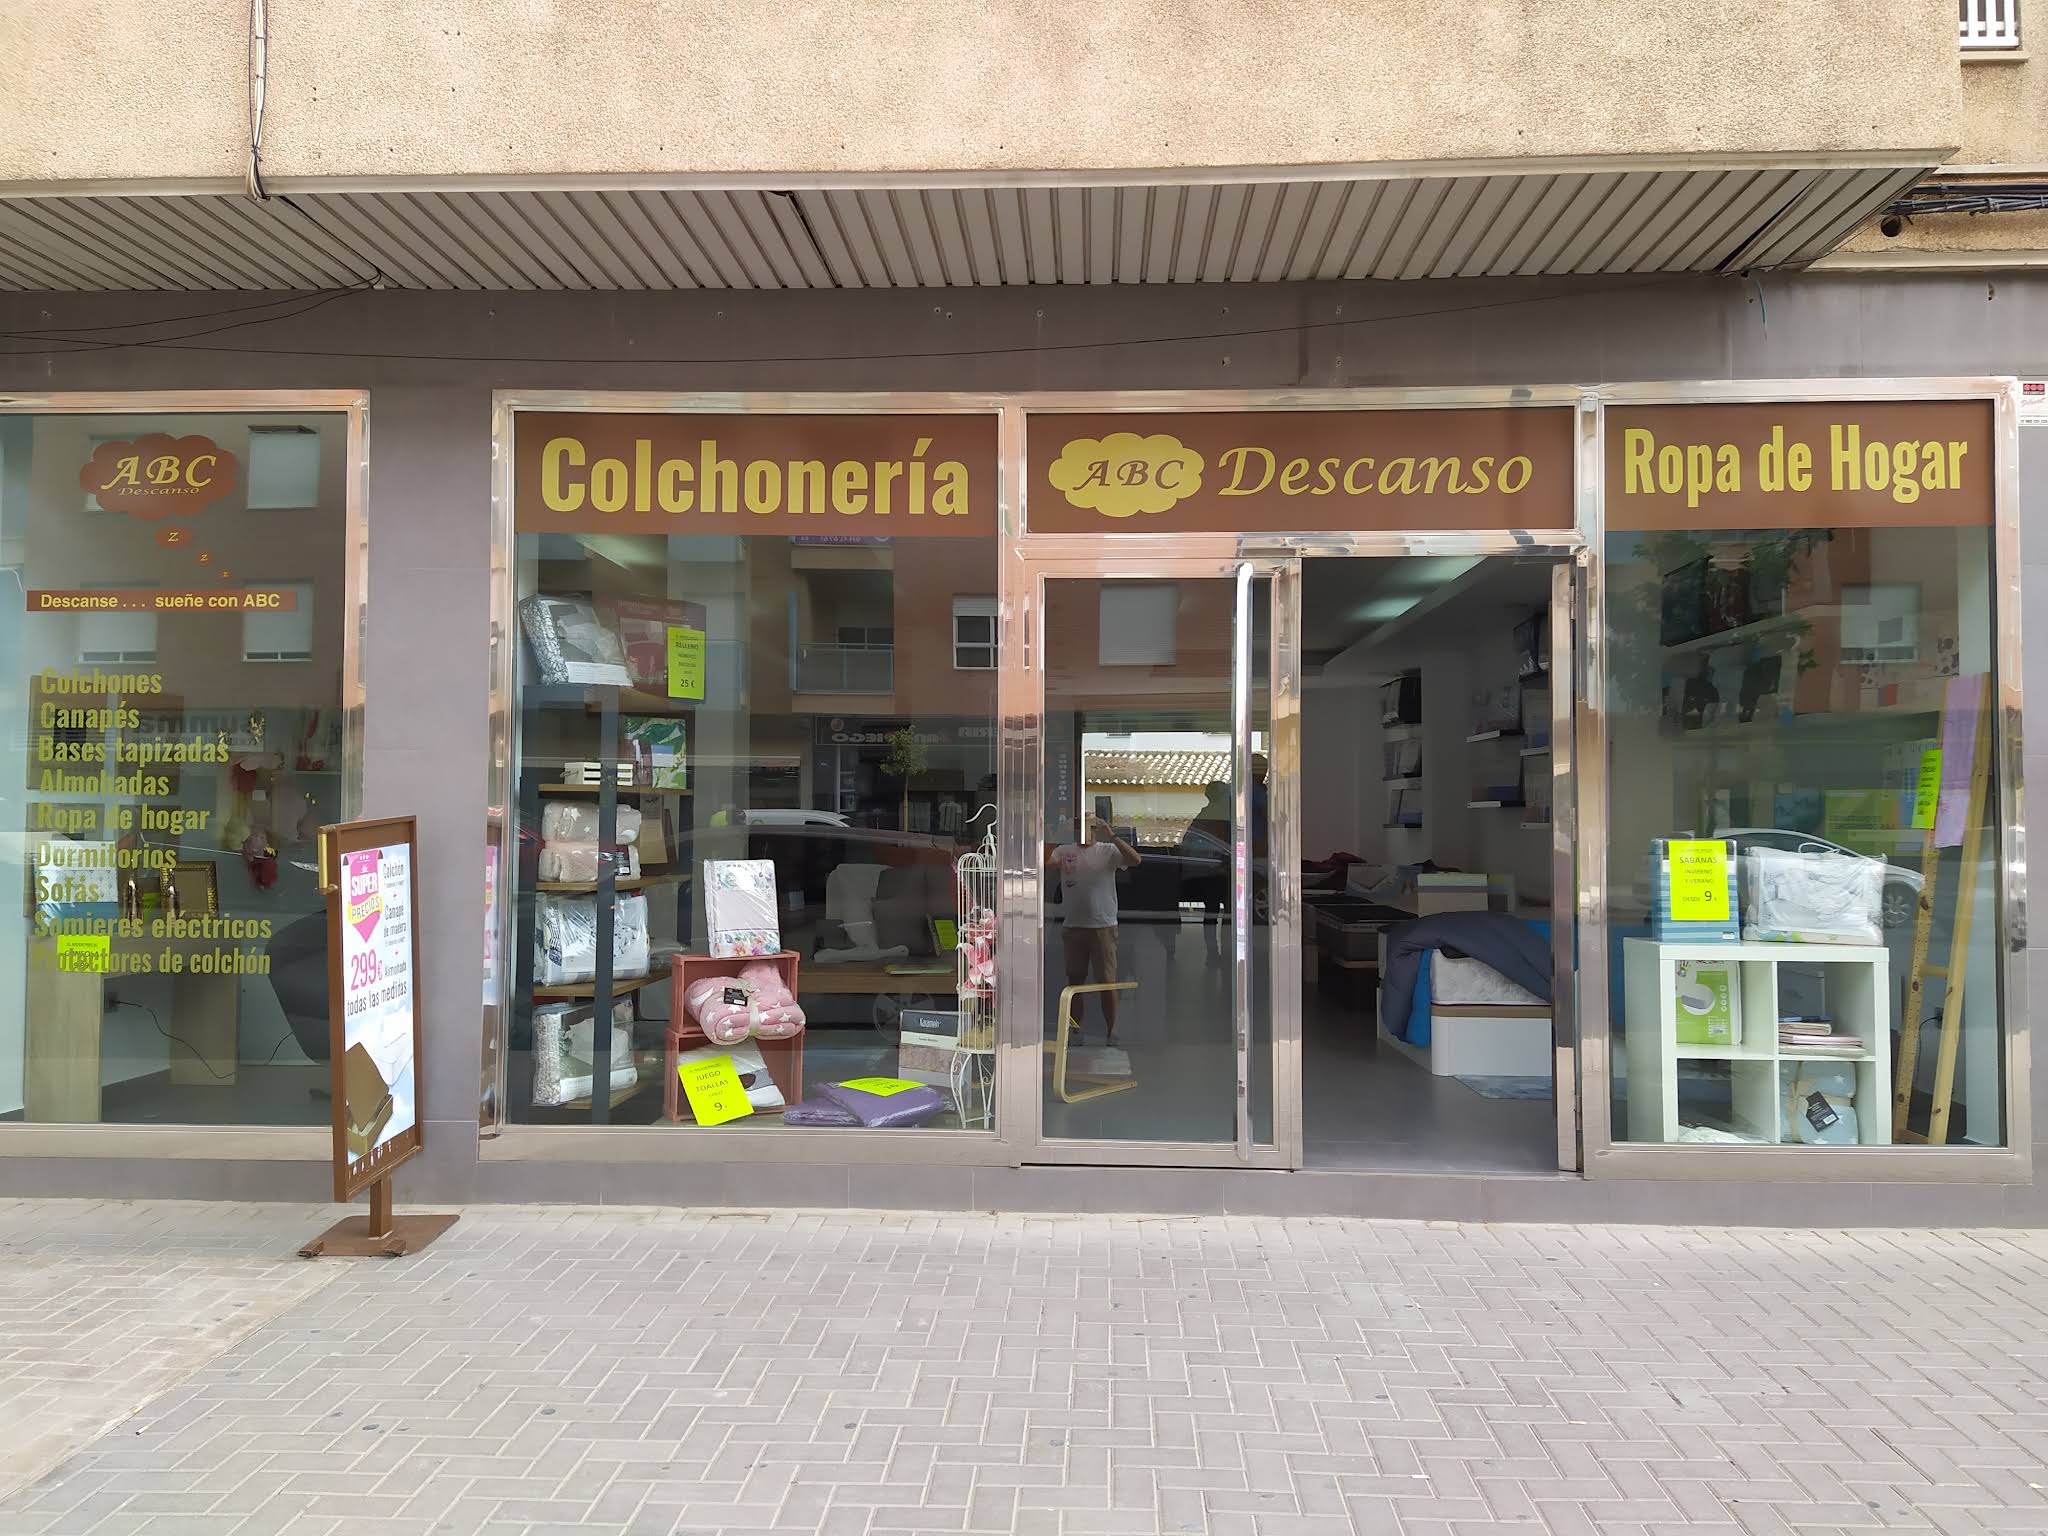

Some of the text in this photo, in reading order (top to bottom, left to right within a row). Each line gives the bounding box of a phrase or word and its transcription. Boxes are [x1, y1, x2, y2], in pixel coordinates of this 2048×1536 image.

[101, 455, 217, 490] ABC
[541, 437, 970, 516] Colchonería
[1072, 446, 1533, 497] ABC Descanso
[1624, 424, 1968, 508] Ropa de Hogar
[118, 486, 200, 496] Descanso
[40, 594, 118, 608] Descanse
[155, 594, 203, 608] sueñe
[208, 597, 238, 608] con
[243, 593, 280, 608] ABC
[40, 668, 162, 694] Colchones
[680, 679, 689, 688] 25
[40, 701, 140, 729] Canapés
[38, 735, 229, 770] Bases tapizadas
[40, 769, 169, 795] Almohadas
[38, 803, 210, 835] Ropa de hogar
[36, 841, 177, 868] Dormitorios
[35, 875, 99, 902] Sofás
[351, 872, 378, 897] SUPER
[1704, 890, 1712, 902] 9
[351, 896, 380, 920] PRECIOS
[34, 911, 272, 939] Somieres eléctricos
[159, 946, 182, 973] de
[189, 946, 271, 974] colchón
[347, 993, 367, 1017] todas
[369, 990, 379, 1009] las
[695, 1080, 729, 1092] TOALLAS
[696, 1070, 721, 1081] JUEGO
[714, 1102, 723, 1111] 9
